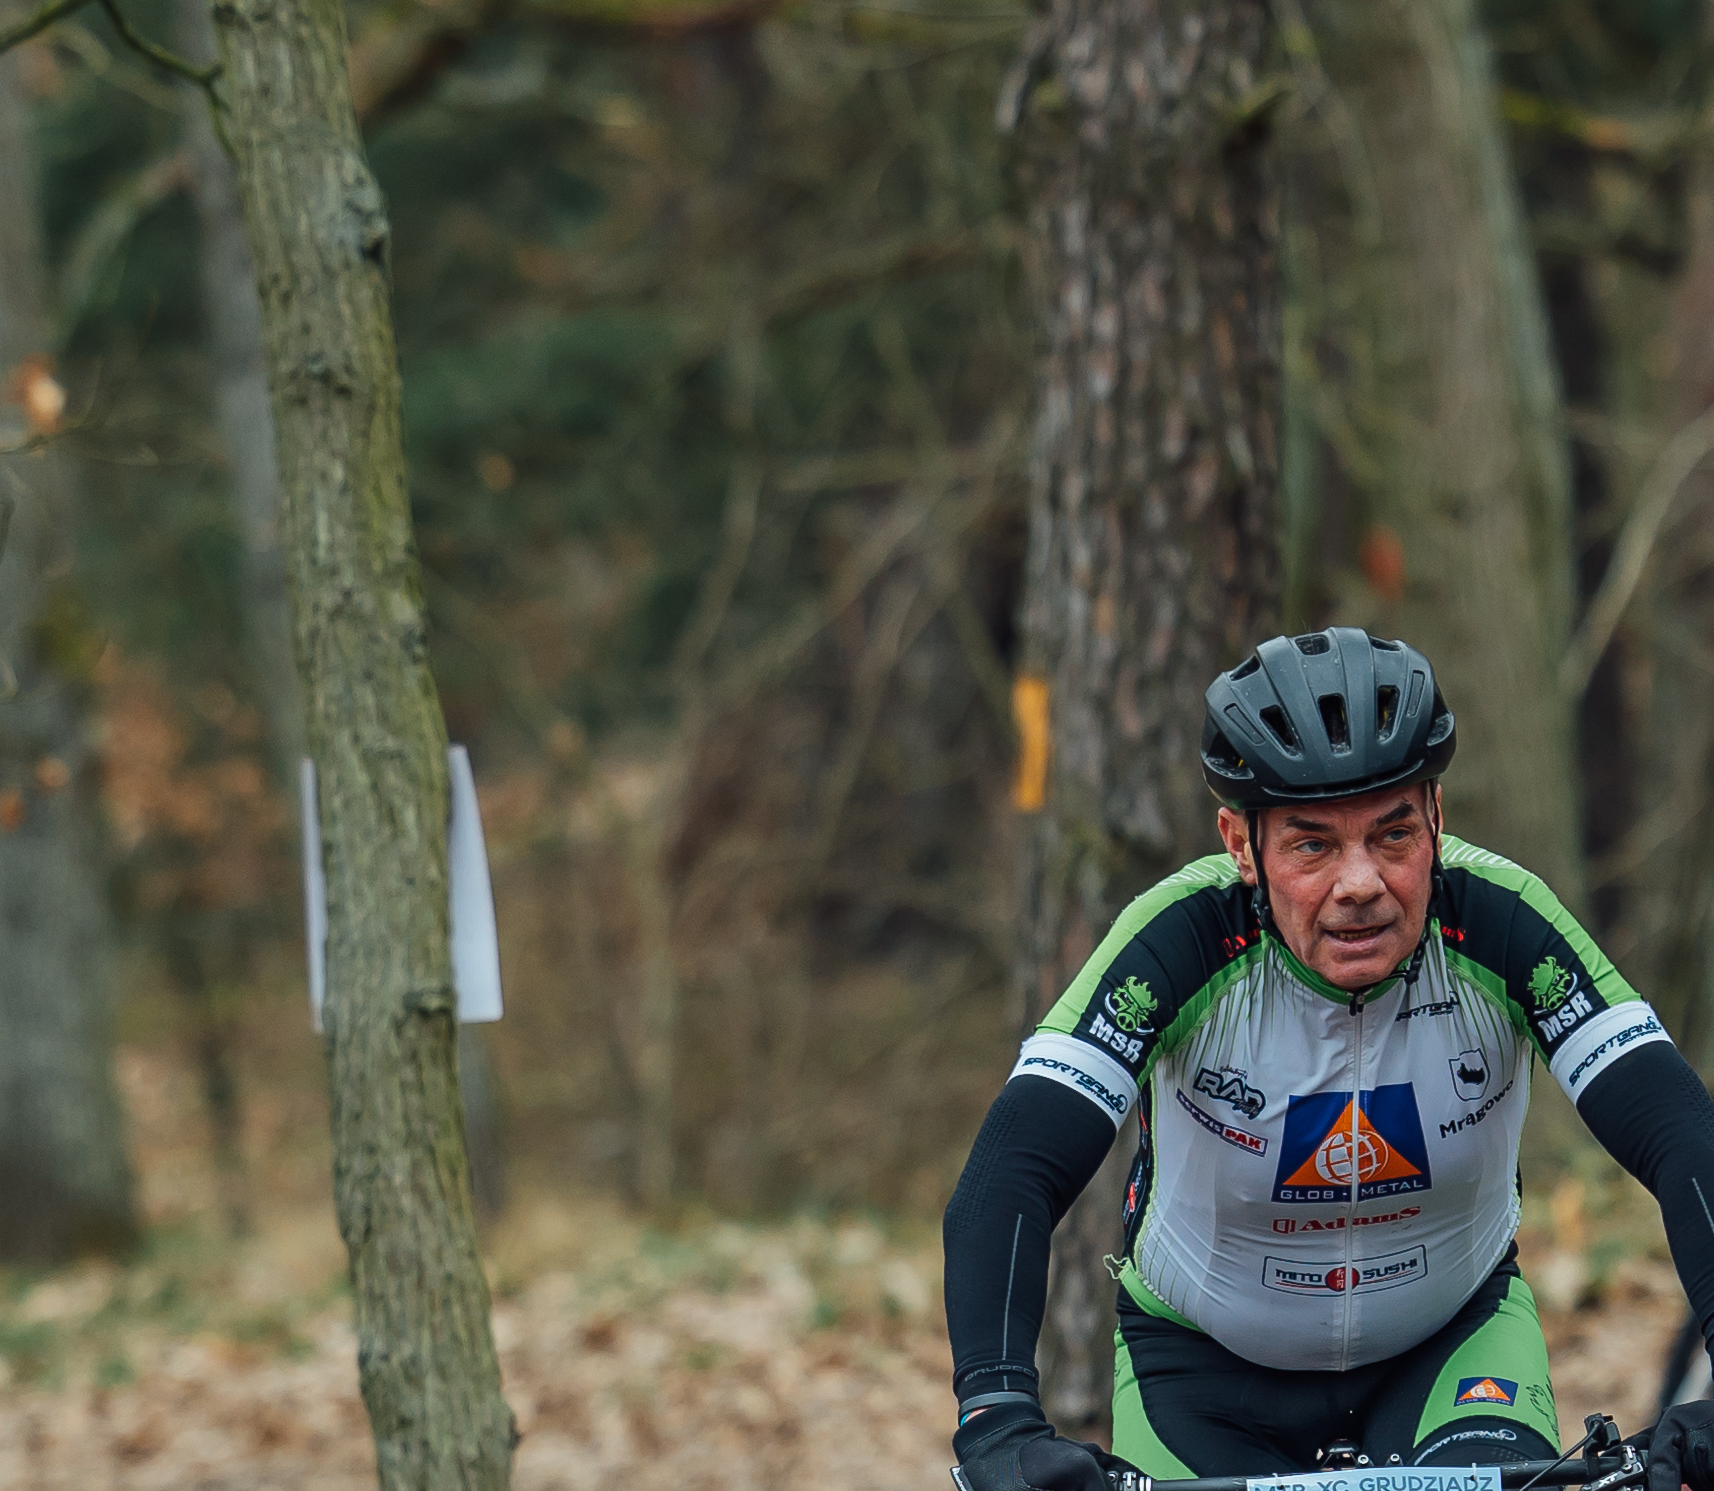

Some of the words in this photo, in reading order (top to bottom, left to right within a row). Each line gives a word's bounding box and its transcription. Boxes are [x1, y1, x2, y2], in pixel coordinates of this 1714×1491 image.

[1088, 1013, 1144, 1064] MSR
[1538, 991, 1593, 1042] MSR
[1569, 1016, 1661, 1087] SPORTGANG
[1022, 1057, 1128, 1114] SPORTGANG
[1193, 1067, 1266, 1112] RAD
[1439, 1080, 1514, 1139] Mrągowo
[1225, 1129, 1261, 1150] PAK
[1280, 1190, 1334, 1200] GLOB
[1361, 1180, 1424, 1197] METAL
[1276, 1268, 1322, 1282] MITO
[1363, 1258, 1417, 1280] SUSHI
